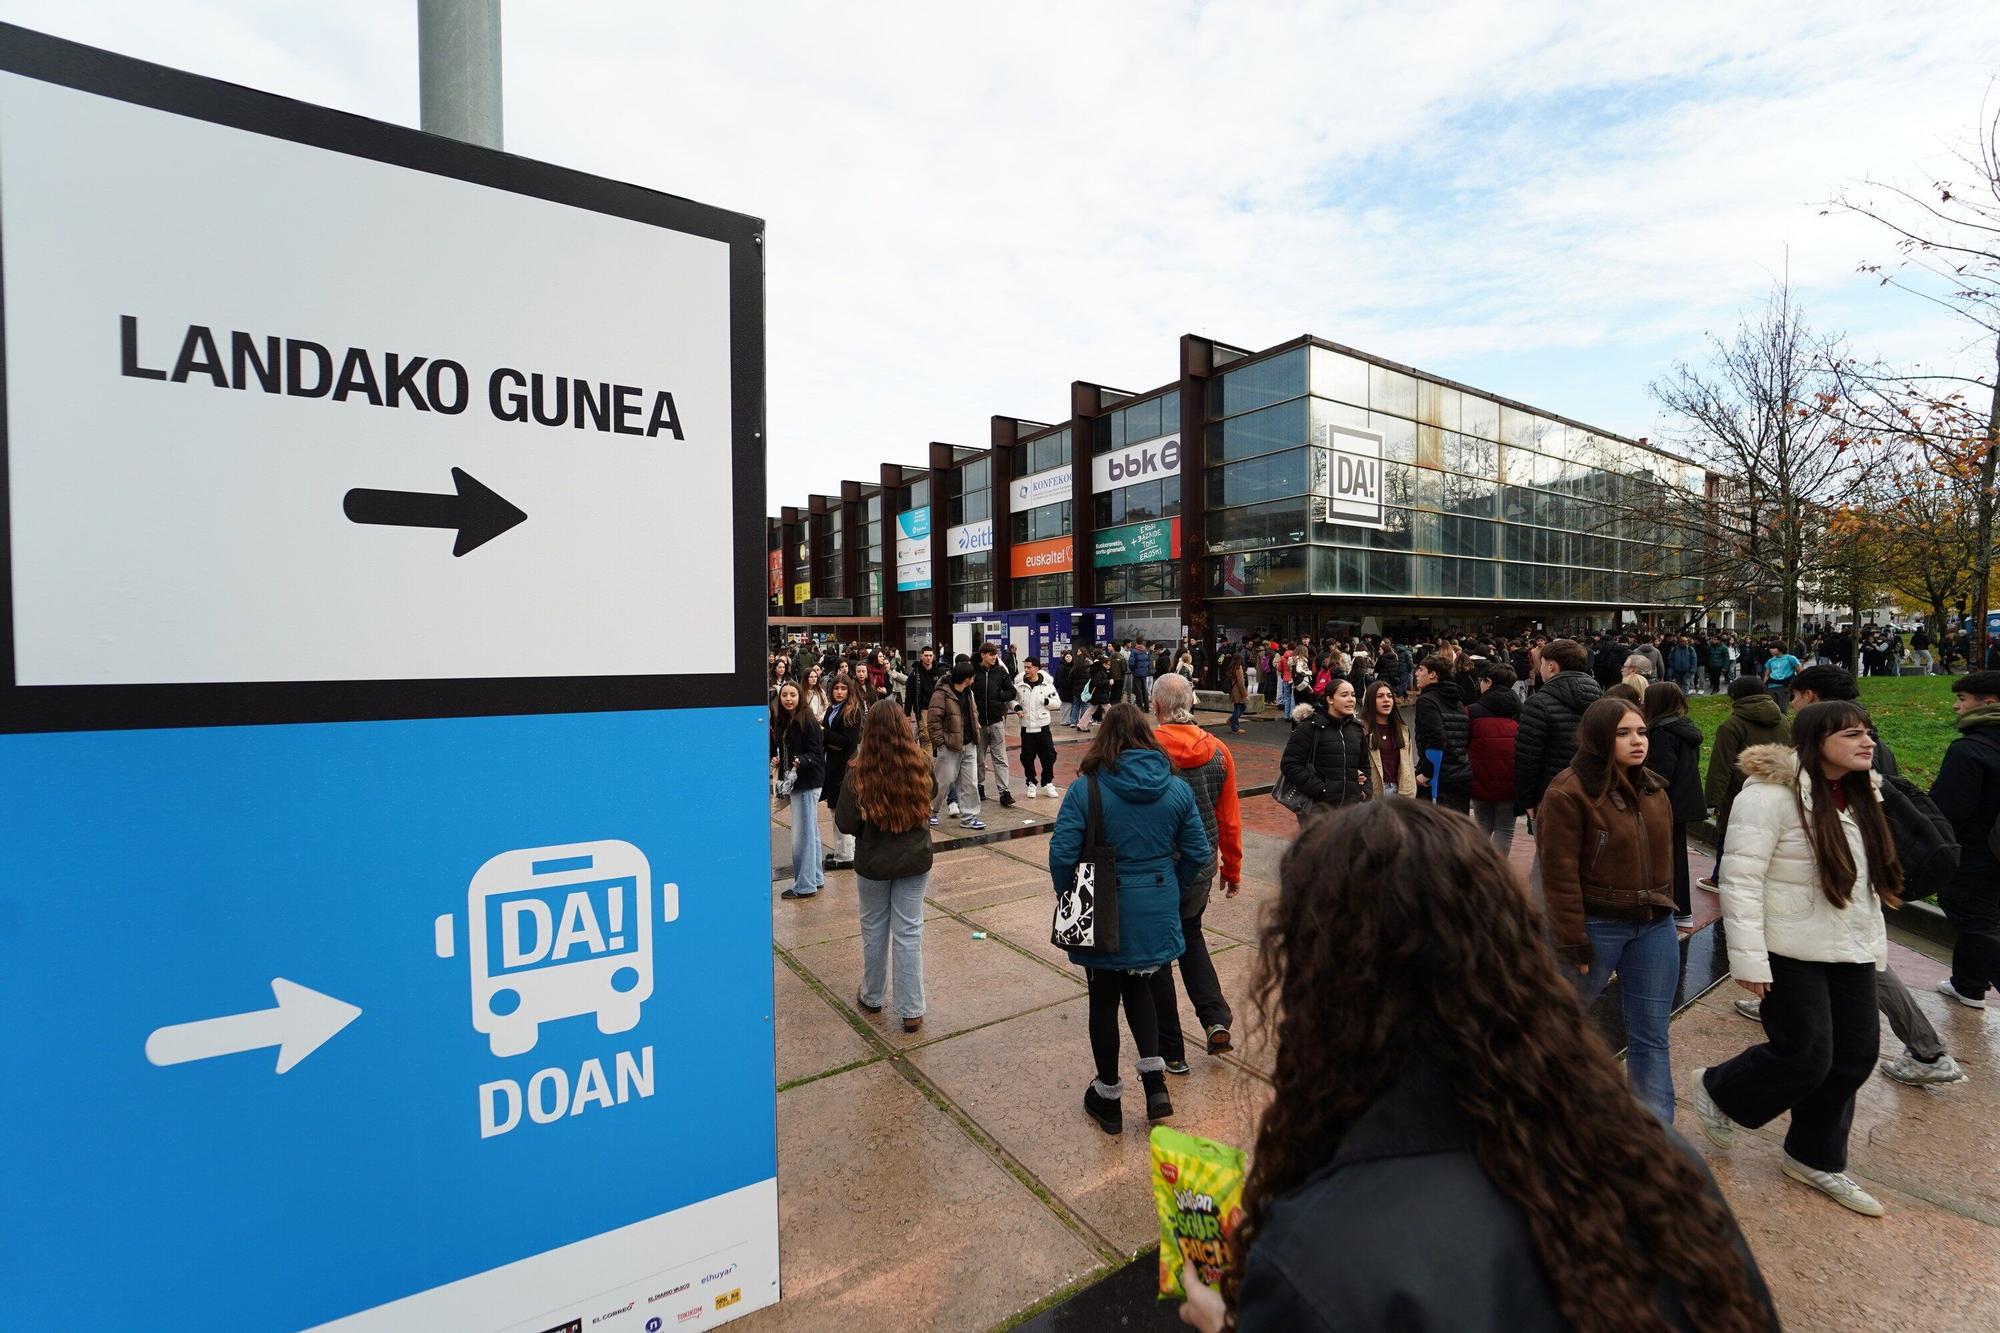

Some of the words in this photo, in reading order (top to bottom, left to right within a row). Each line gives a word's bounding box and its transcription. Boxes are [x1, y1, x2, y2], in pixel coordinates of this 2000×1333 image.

[121, 315, 469, 415] LANDAKO
[489, 368, 685, 441] GUNEA
[1108, 449, 1158, 481] bbk
[1338, 456, 1375, 498] DA!
[1026, 549, 1065, 567] euskaltel
[1139, 548, 1162, 561] EROSKI
[502, 887, 625, 969] DA!
[478, 1046, 655, 1139] DOAN
[701, 1267, 733, 1285] elhuyar
[602, 1305, 634, 1320] CORREO
